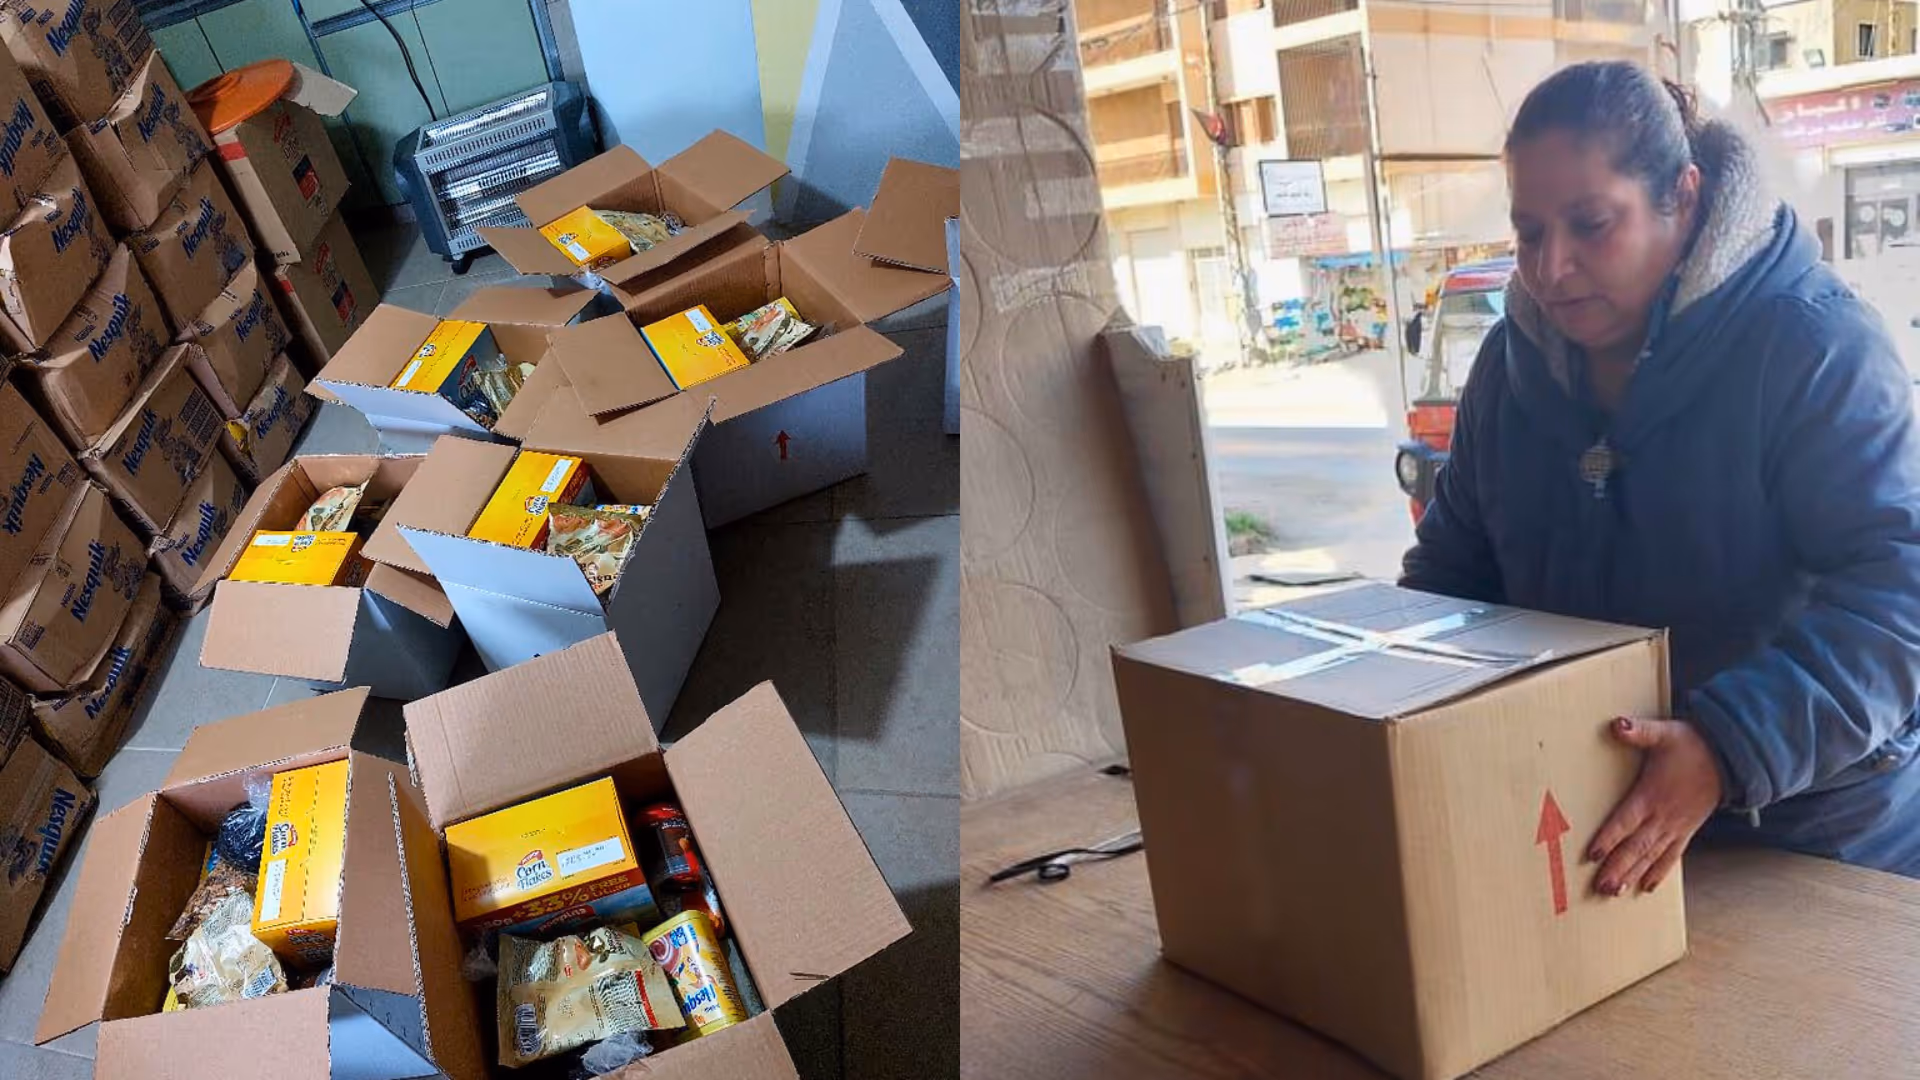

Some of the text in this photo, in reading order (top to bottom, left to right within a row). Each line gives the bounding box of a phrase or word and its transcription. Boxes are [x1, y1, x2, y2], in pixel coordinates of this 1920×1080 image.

[46, 0, 86, 57] Nesqui
[88, 291, 131, 363] Nesquik
[122, 408, 157, 476] Nesquik
[2, 452, 46, 536] Nesquik
[181, 499, 216, 567] Nesquik
[70, 538, 106, 622] Nesquik
[84, 645, 131, 721] Nesquik
[36, 788, 76, 875] Nesquik
[516, 859, 546, 878] Corn
[517, 868, 554, 890] Flakes
[683, 982, 718, 1017] Nesqu
